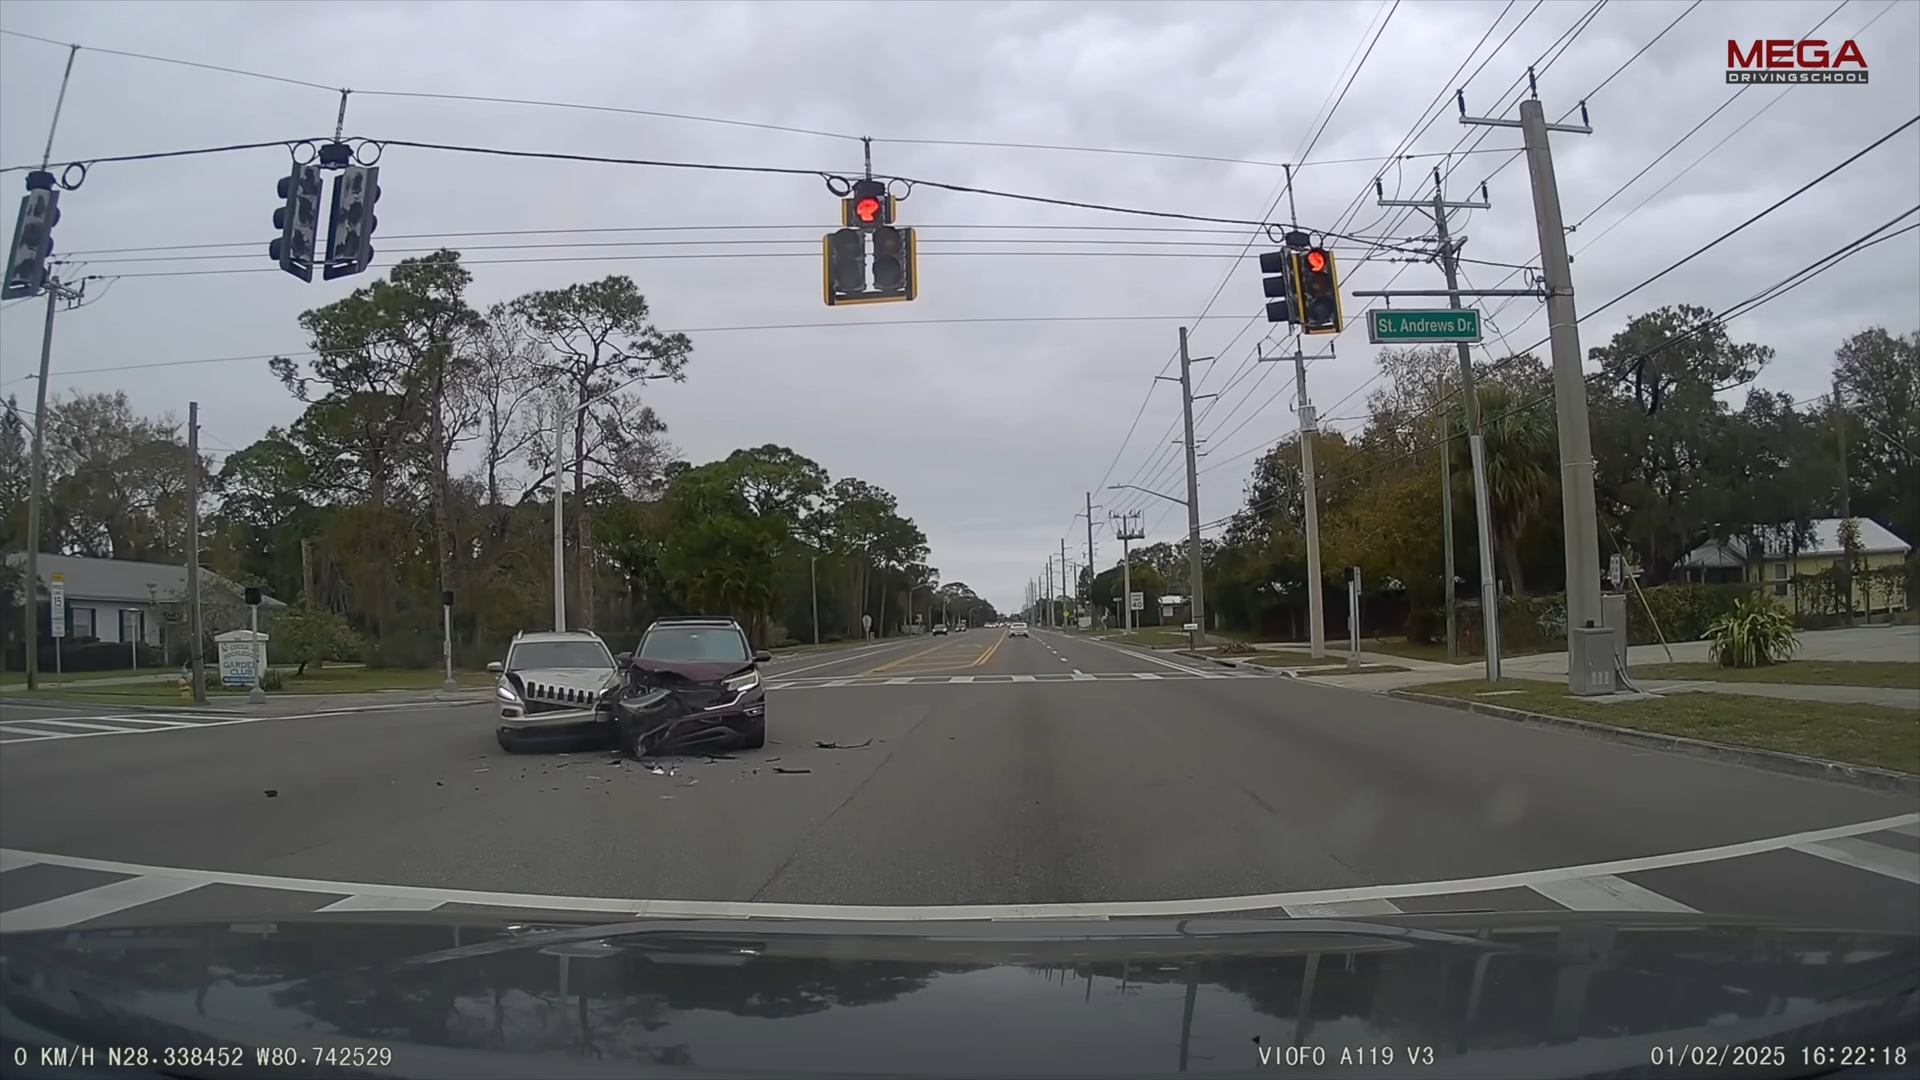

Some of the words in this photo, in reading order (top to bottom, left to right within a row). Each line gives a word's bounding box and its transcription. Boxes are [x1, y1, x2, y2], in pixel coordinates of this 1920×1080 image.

[1378, 318, 1397, 332] St.
[1400, 318, 1455, 332] Andrews
[1457, 318, 1475, 332] Dr.
[54, 596, 62, 607] 15
[223, 661, 257, 669] GARDE
